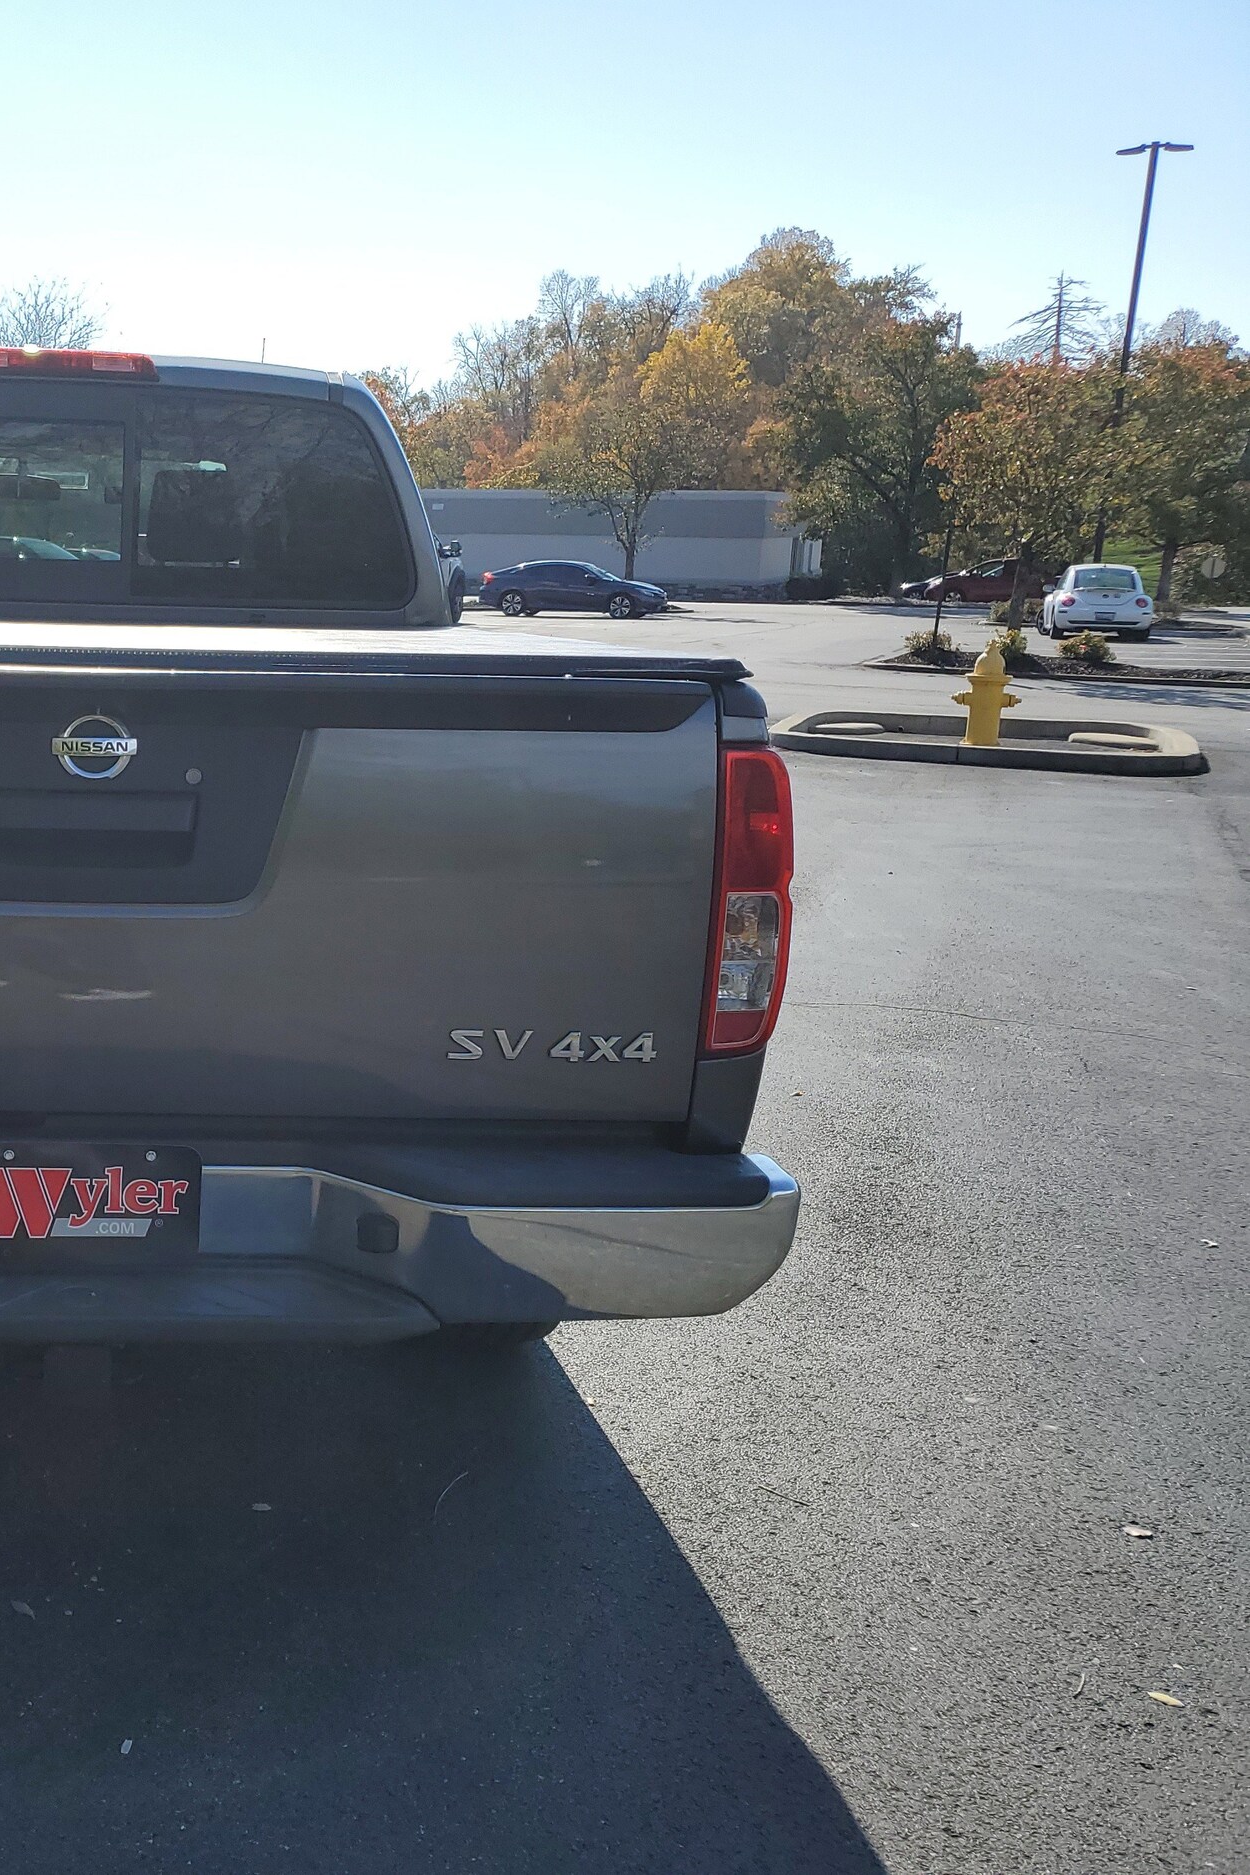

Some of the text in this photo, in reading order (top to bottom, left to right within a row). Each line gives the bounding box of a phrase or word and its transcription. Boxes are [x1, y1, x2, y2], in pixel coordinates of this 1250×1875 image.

[61, 741, 128, 752] NISSAN
[549, 1031, 658, 1062] 4x4
[95, 1222, 135, 1235] .COM
